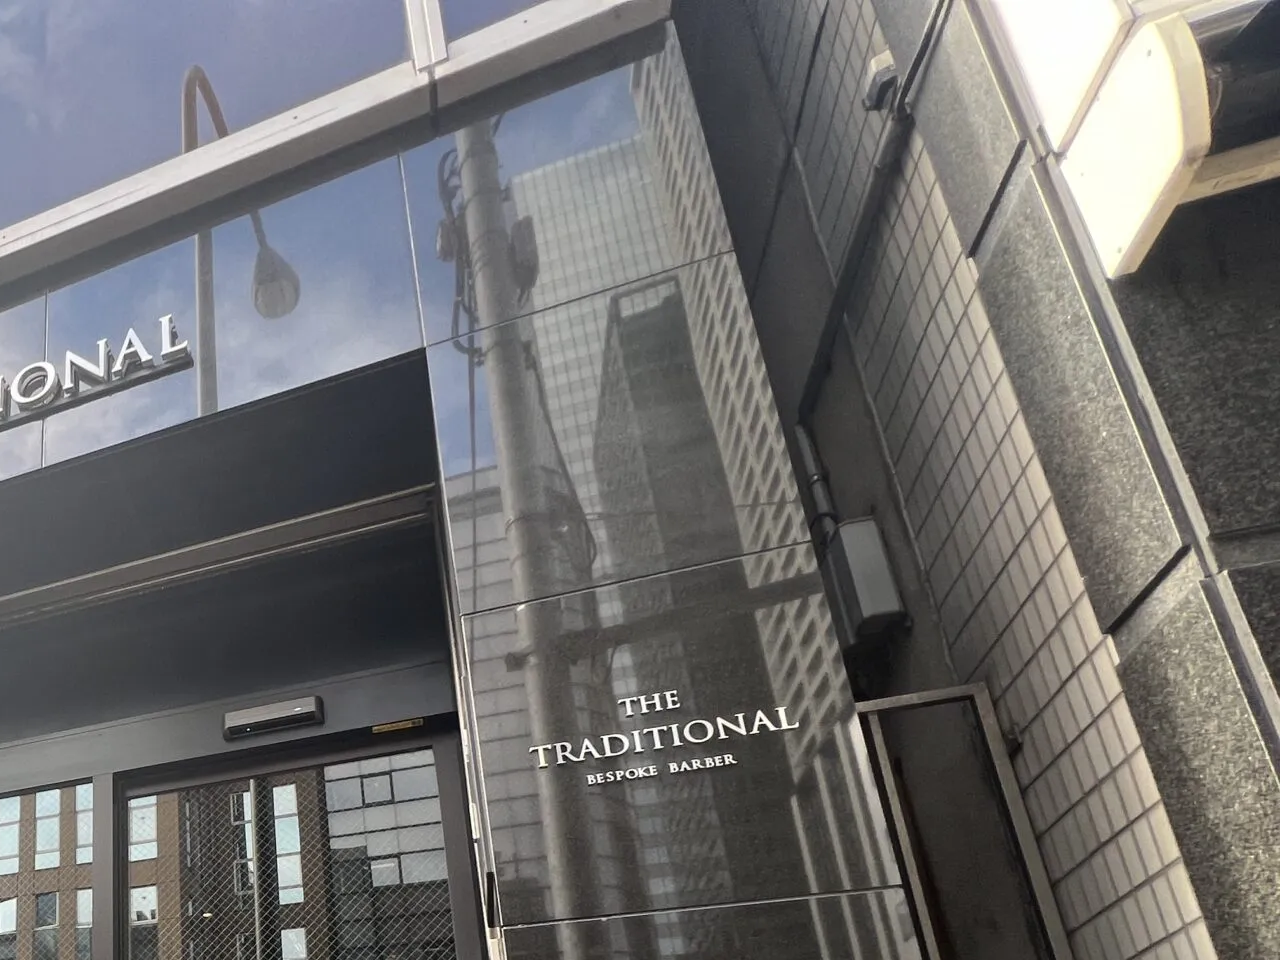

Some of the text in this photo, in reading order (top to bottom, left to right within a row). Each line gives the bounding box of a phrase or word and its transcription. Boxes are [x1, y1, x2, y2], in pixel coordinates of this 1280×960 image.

[617, 689, 681, 716] THE
[528, 706, 800, 768] TRADITIONAL
[586, 753, 738, 785] BESPOKE BARBER
